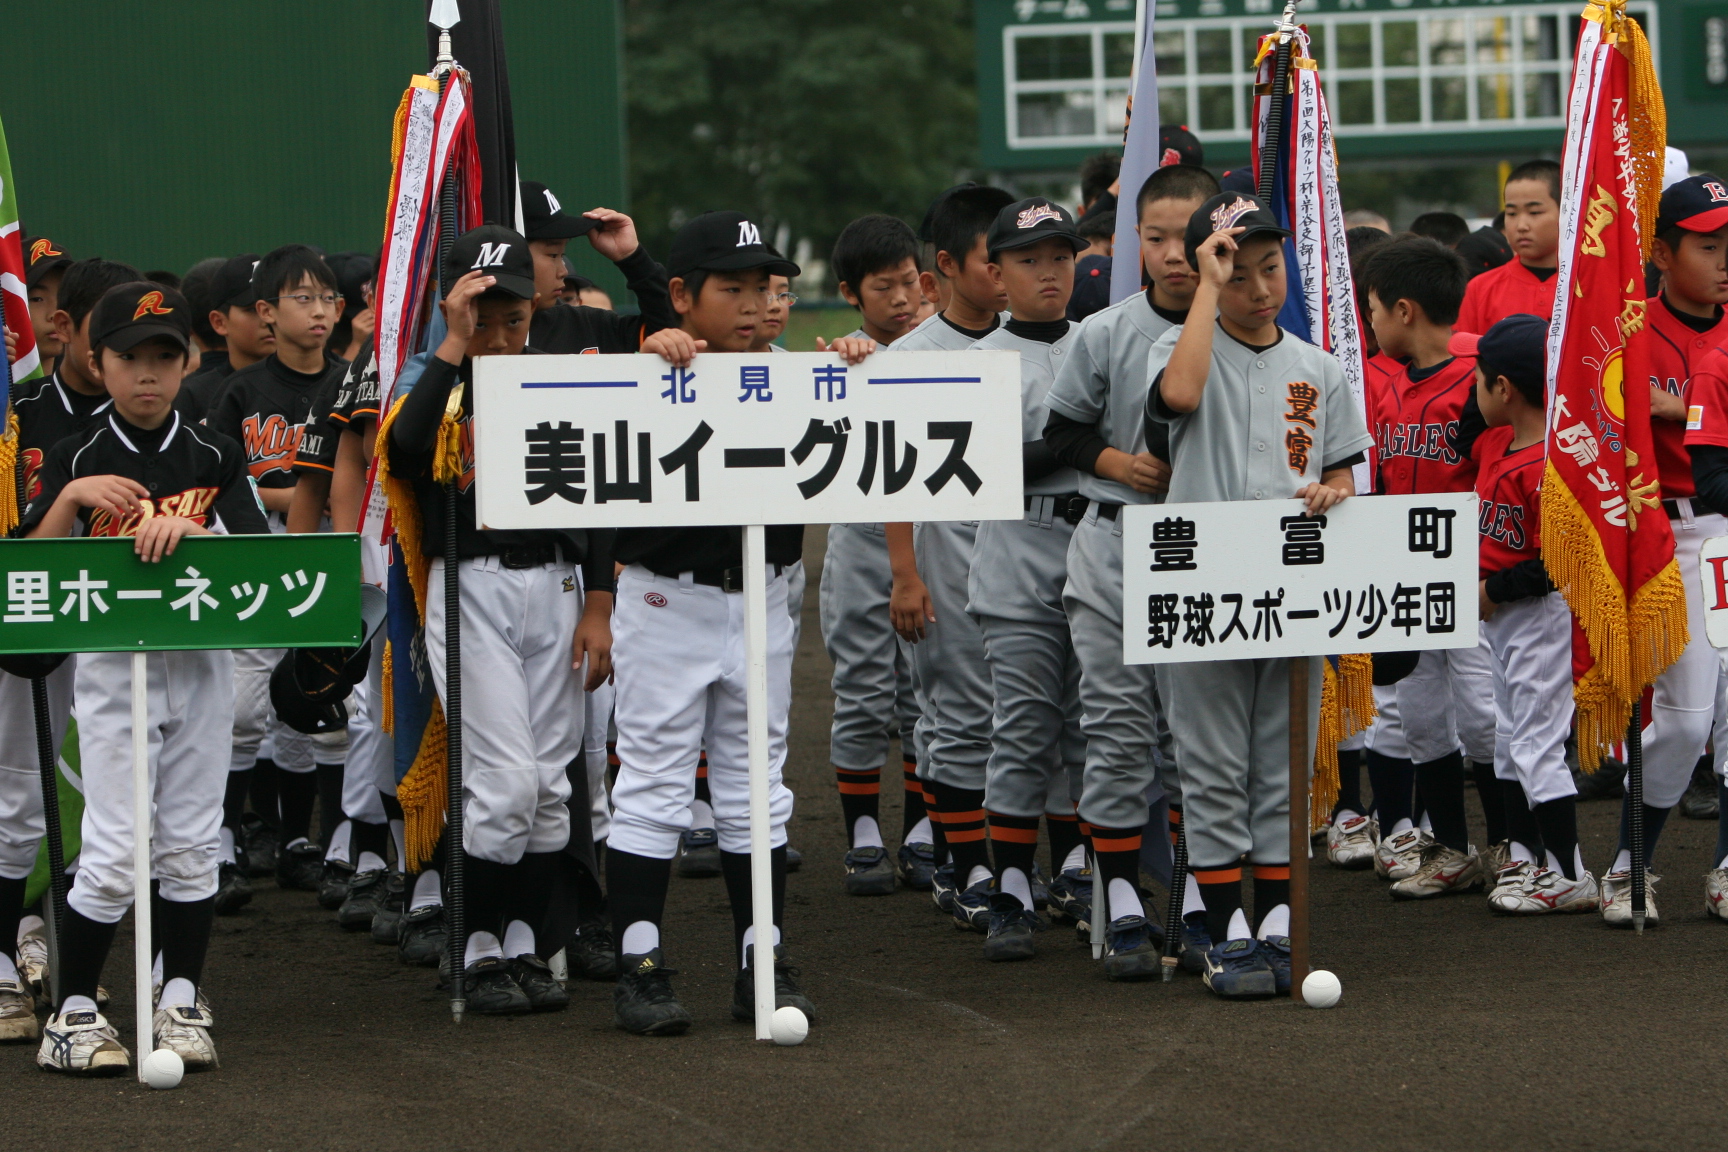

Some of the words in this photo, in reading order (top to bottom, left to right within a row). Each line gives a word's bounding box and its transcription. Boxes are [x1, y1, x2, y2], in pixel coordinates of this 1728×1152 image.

[471, 242, 512, 269] M
[736, 221, 762, 247] M
[661, 364, 848, 404] 北見市
[524, 415, 984, 507] 美山イーグルス
[1149, 506, 1457, 572] 豊富町
[3, 565, 327, 623] 里ホーネッツ
[1147, 582, 1456, 649] 野球スポーツ少年団
